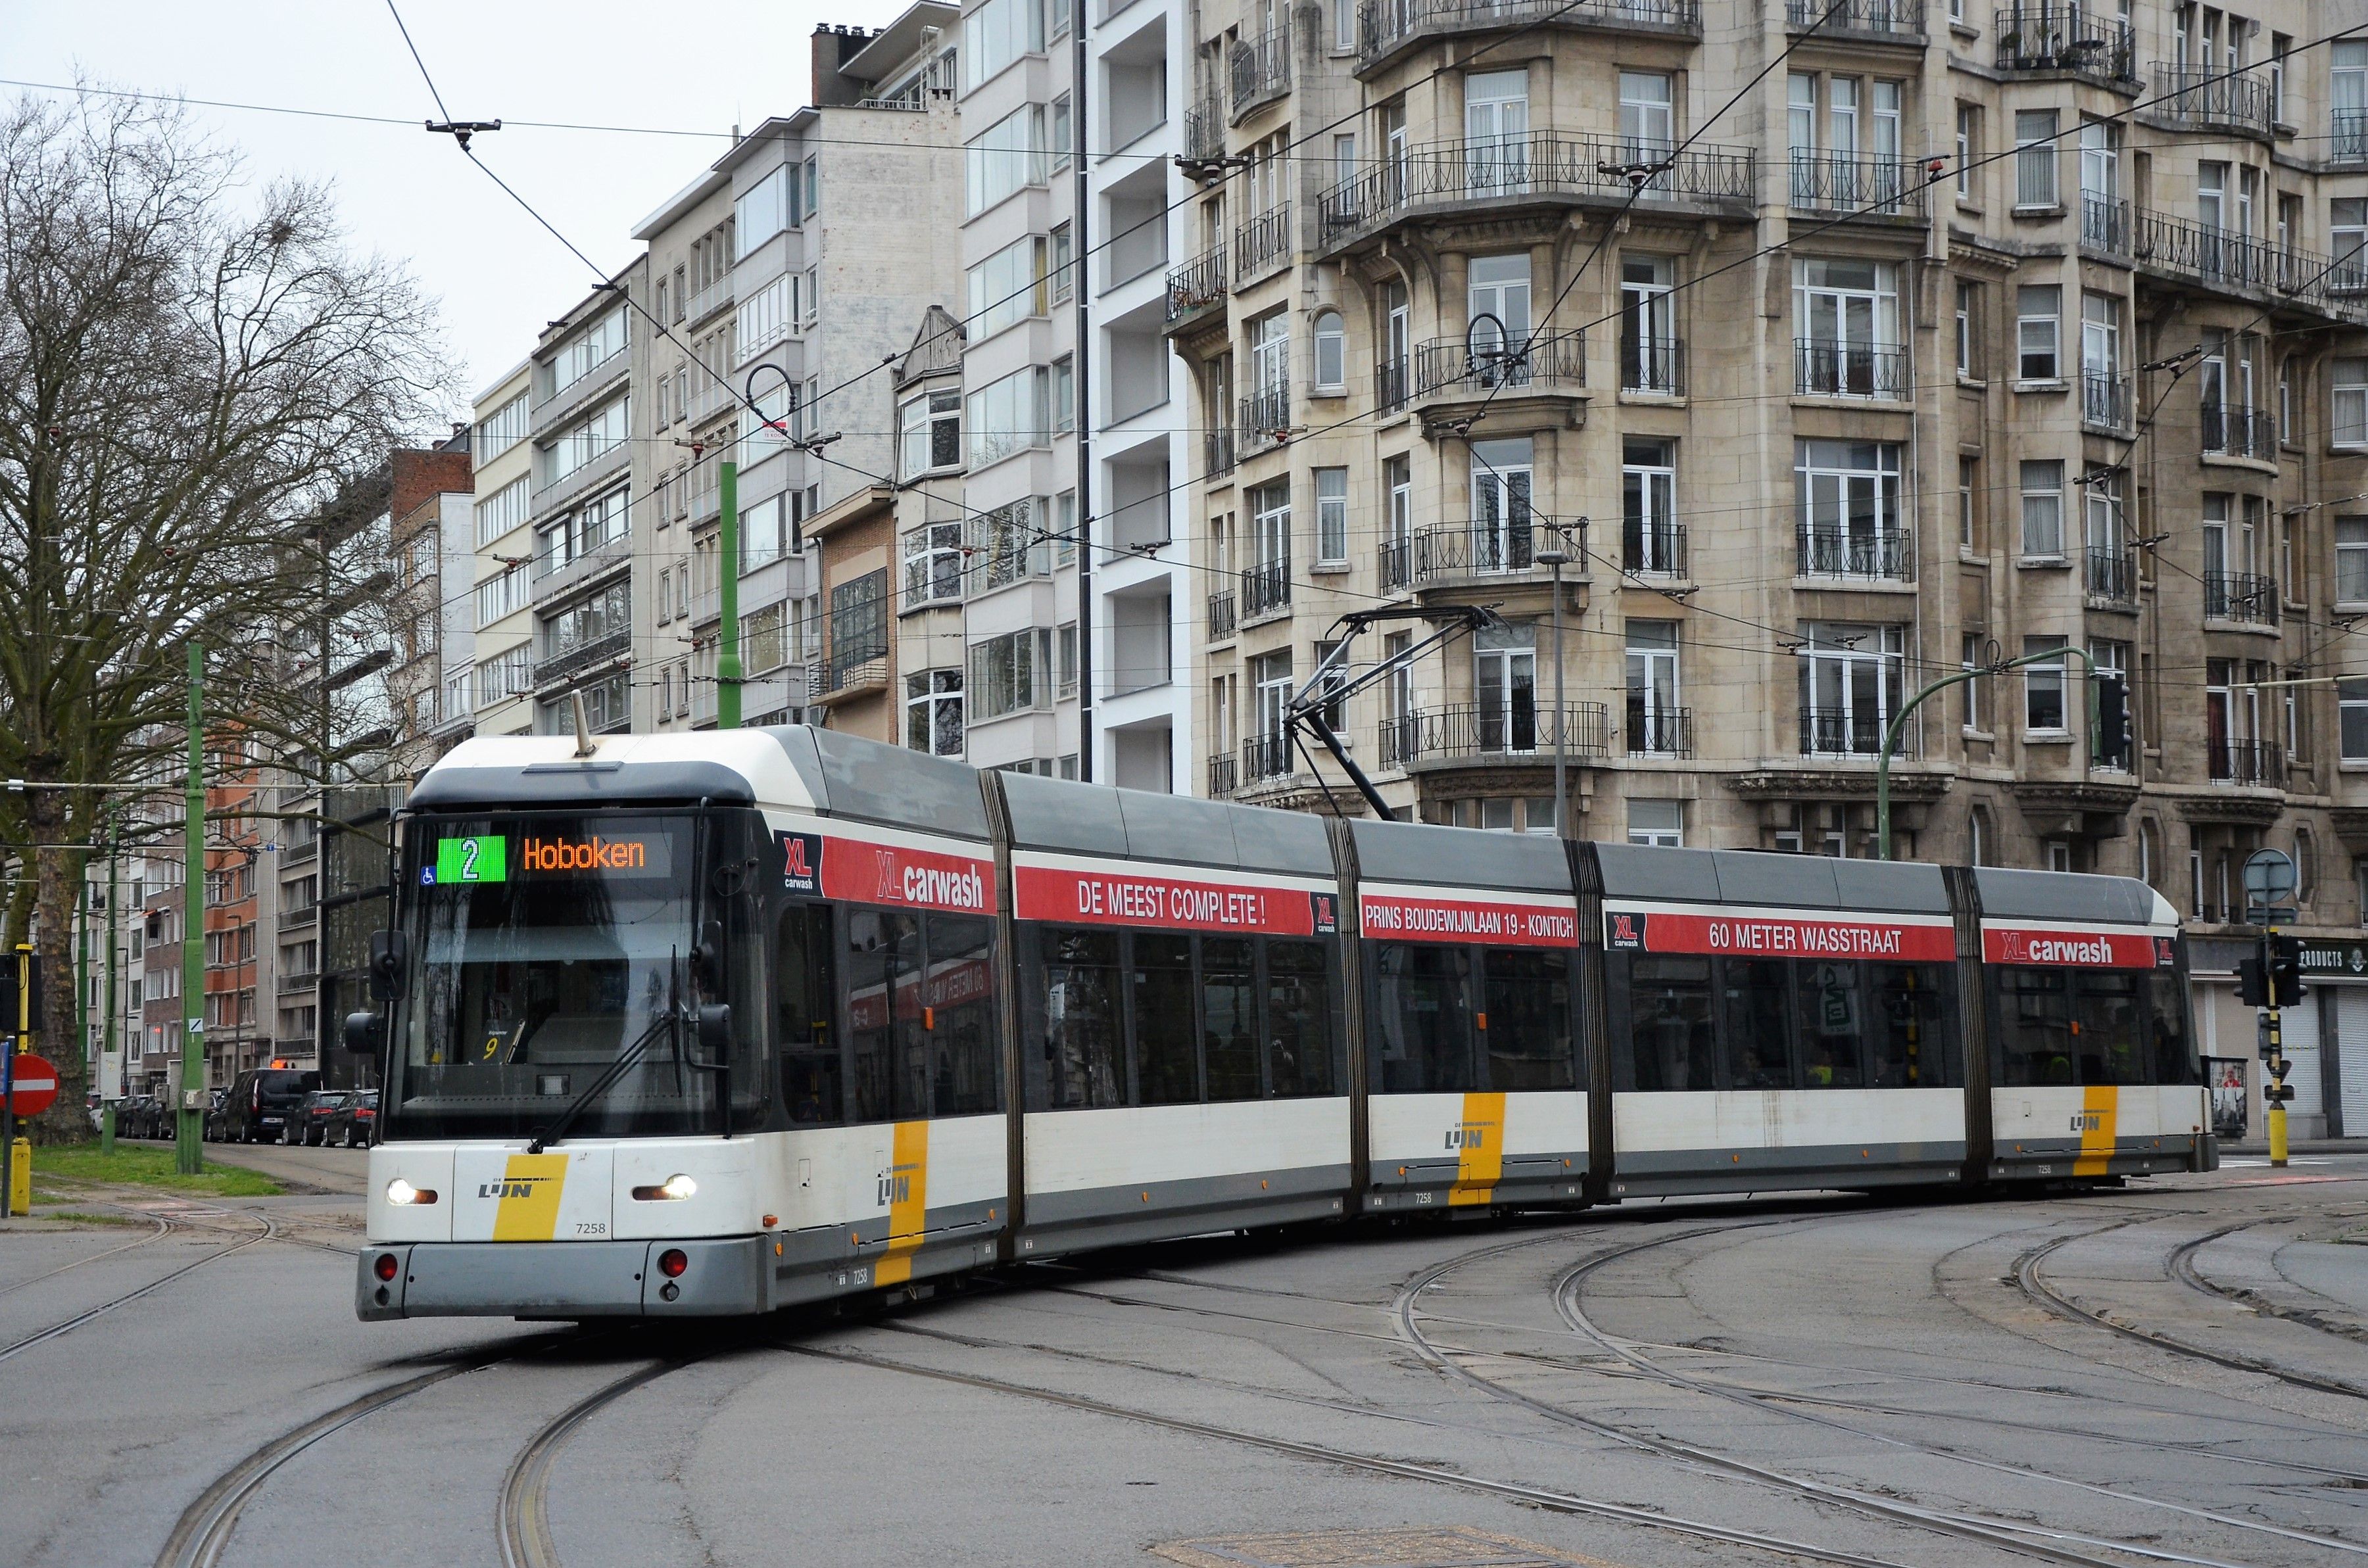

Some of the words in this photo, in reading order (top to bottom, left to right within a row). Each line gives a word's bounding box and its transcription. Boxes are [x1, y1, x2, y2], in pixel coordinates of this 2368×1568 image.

[462, 838, 479, 880] 2
[524, 837, 644, 869] Hoboken
[784, 837, 812, 877] XL
[785, 877, 813, 890] carwash
[876, 850, 902, 899] XL
[904, 864, 983, 909] carwash
[1078, 880, 1103, 914] DE
[1108, 883, 1165, 917] MEEST
[1171, 887, 1257, 924] COMPLETE
[1317, 897, 1334, 924] XL
[1366, 905, 1401, 930] PRINS
[1406, 907, 1501, 934] BOUDEWIJNLAAN
[1505, 913, 1518, 935] 19
[1529, 915, 1574, 938] KONTICH
[1614, 915, 1637, 939] XL
[1710, 922, 1729, 948] 60
[1736, 924, 1797, 950] METER
[1800, 926, 1902, 953] WASSTRAAT
[2002, 932, 2027, 960] XL
[2029, 937, 2112, 963] carwash
[2301, 951, 2342, 966] PRODUCTS
[483, 1037, 498, 1060] 9
[1445, 1129, 1483, 1149] LIJN
[479, 1184, 532, 1198] LIJN
[877, 1176, 909, 1206] LIJN
[1416, 1193, 1432, 1203] 7258
[577, 1224, 606, 1233] 7258
[854, 1268, 867, 1285] 7258
